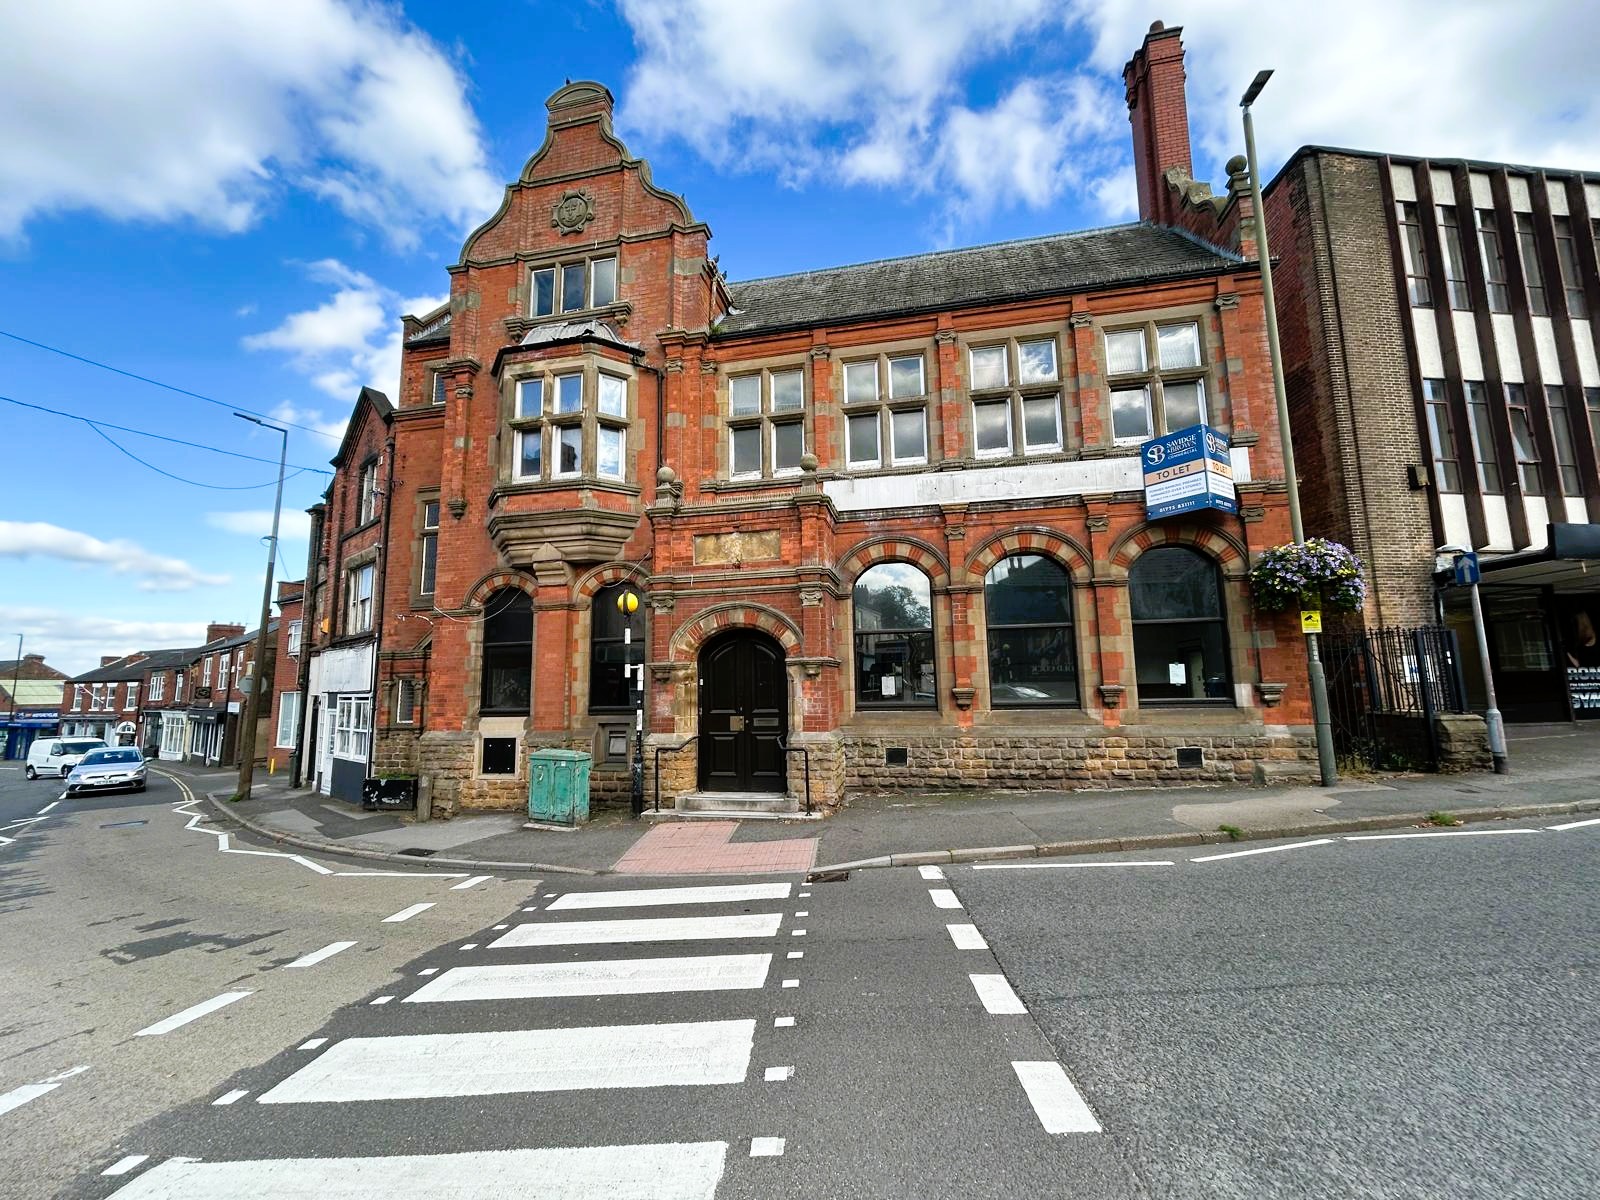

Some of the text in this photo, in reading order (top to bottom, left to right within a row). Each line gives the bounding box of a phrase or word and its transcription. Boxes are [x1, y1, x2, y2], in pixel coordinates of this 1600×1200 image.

[1166, 434, 1197, 447] SAVIDGE
[1156, 465, 1190, 479] TO LET
